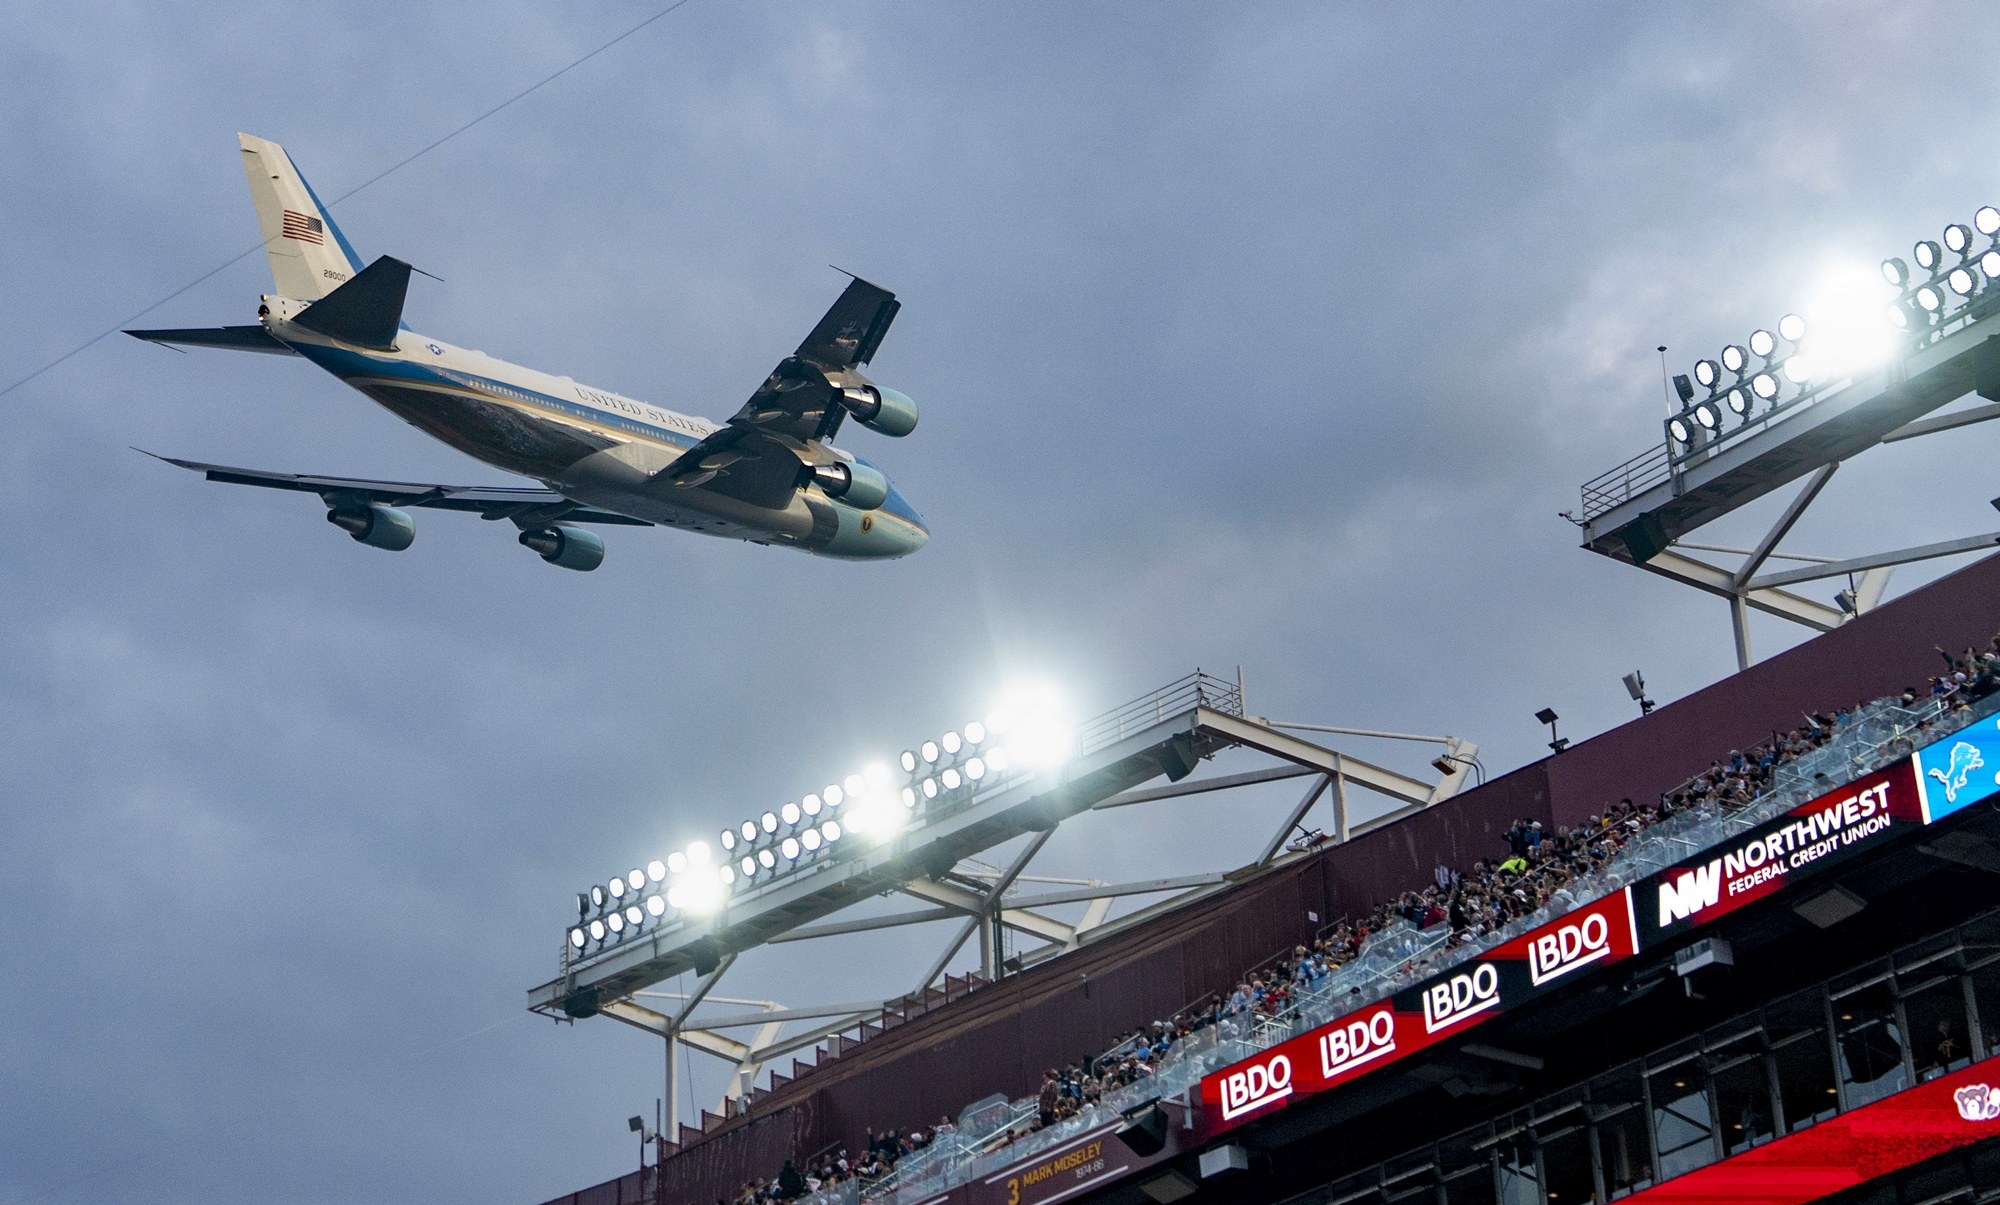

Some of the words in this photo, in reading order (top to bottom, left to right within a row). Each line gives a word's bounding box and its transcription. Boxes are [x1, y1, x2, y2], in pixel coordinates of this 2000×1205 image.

[574, 387, 642, 415] UNITED
[646, 408, 709, 436] STATES
[1724, 781, 1891, 878] NORTHWEST
[1728, 863, 1790, 896] FEDERAL
[1790, 838, 1839, 867] CREDIT
[1842, 813, 1891, 845] UNION
[1659, 859, 1722, 928] NW
[1537, 913, 1608, 972] BDO
[1432, 963, 1498, 1020] BDO
[1329, 1010, 1394, 1065] BDO
[1229, 1054, 1292, 1108] BDO
[1007, 1178, 1020, 1205] 3
[1023, 1163, 1055, 1187] MARK
[1055, 1141, 1103, 1174] MOSELEY
[1075, 1159, 1104, 1179] 1974-86
